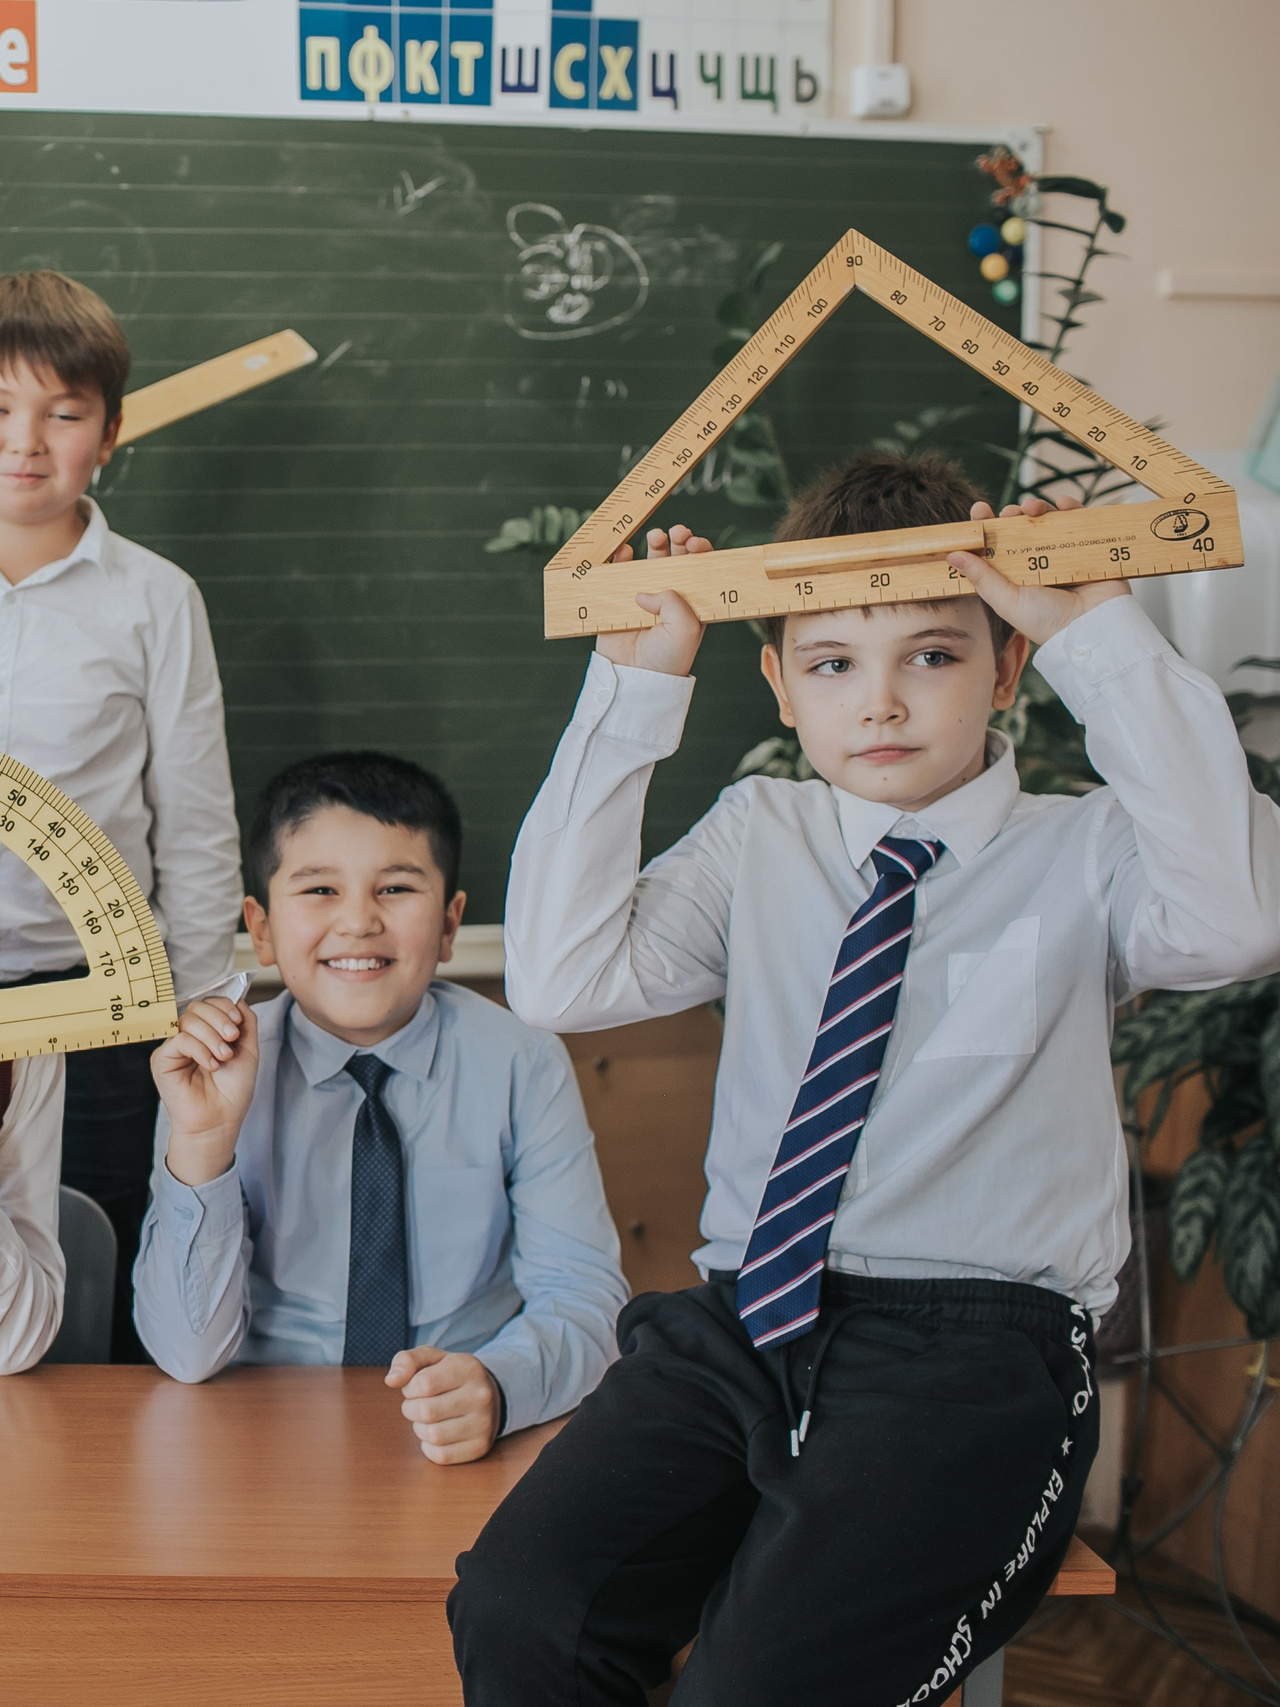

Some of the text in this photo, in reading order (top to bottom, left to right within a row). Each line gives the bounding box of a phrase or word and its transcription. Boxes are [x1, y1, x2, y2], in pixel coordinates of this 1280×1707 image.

[571, 255, 1197, 581] 180 170 160 150 140 130 120 110 100 90 80 70 60 50 40 30 20 10 0
[578, 536, 1215, 620] 0 10 15 20 2 30 35 40
[6, 788, 28, 808] 50
[47, 819, 67, 840] 40
[80, 855, 99, 877] 30
[106, 898, 125, 919] 20
[125, 945, 141, 966] 10
[137, 999, 151, 1008] 0
[26, 837, 51, 862] 140
[57, 870, 80, 897] 150
[81, 908, 103, 936] 160
[98, 950, 117, 977] 170
[109, 994, 125, 1021] 180
[111, 1029, 120, 1037] 45
[1004, 1467, 1065, 1583] EXPLORE
[980, 1580, 1002, 1619] IN
